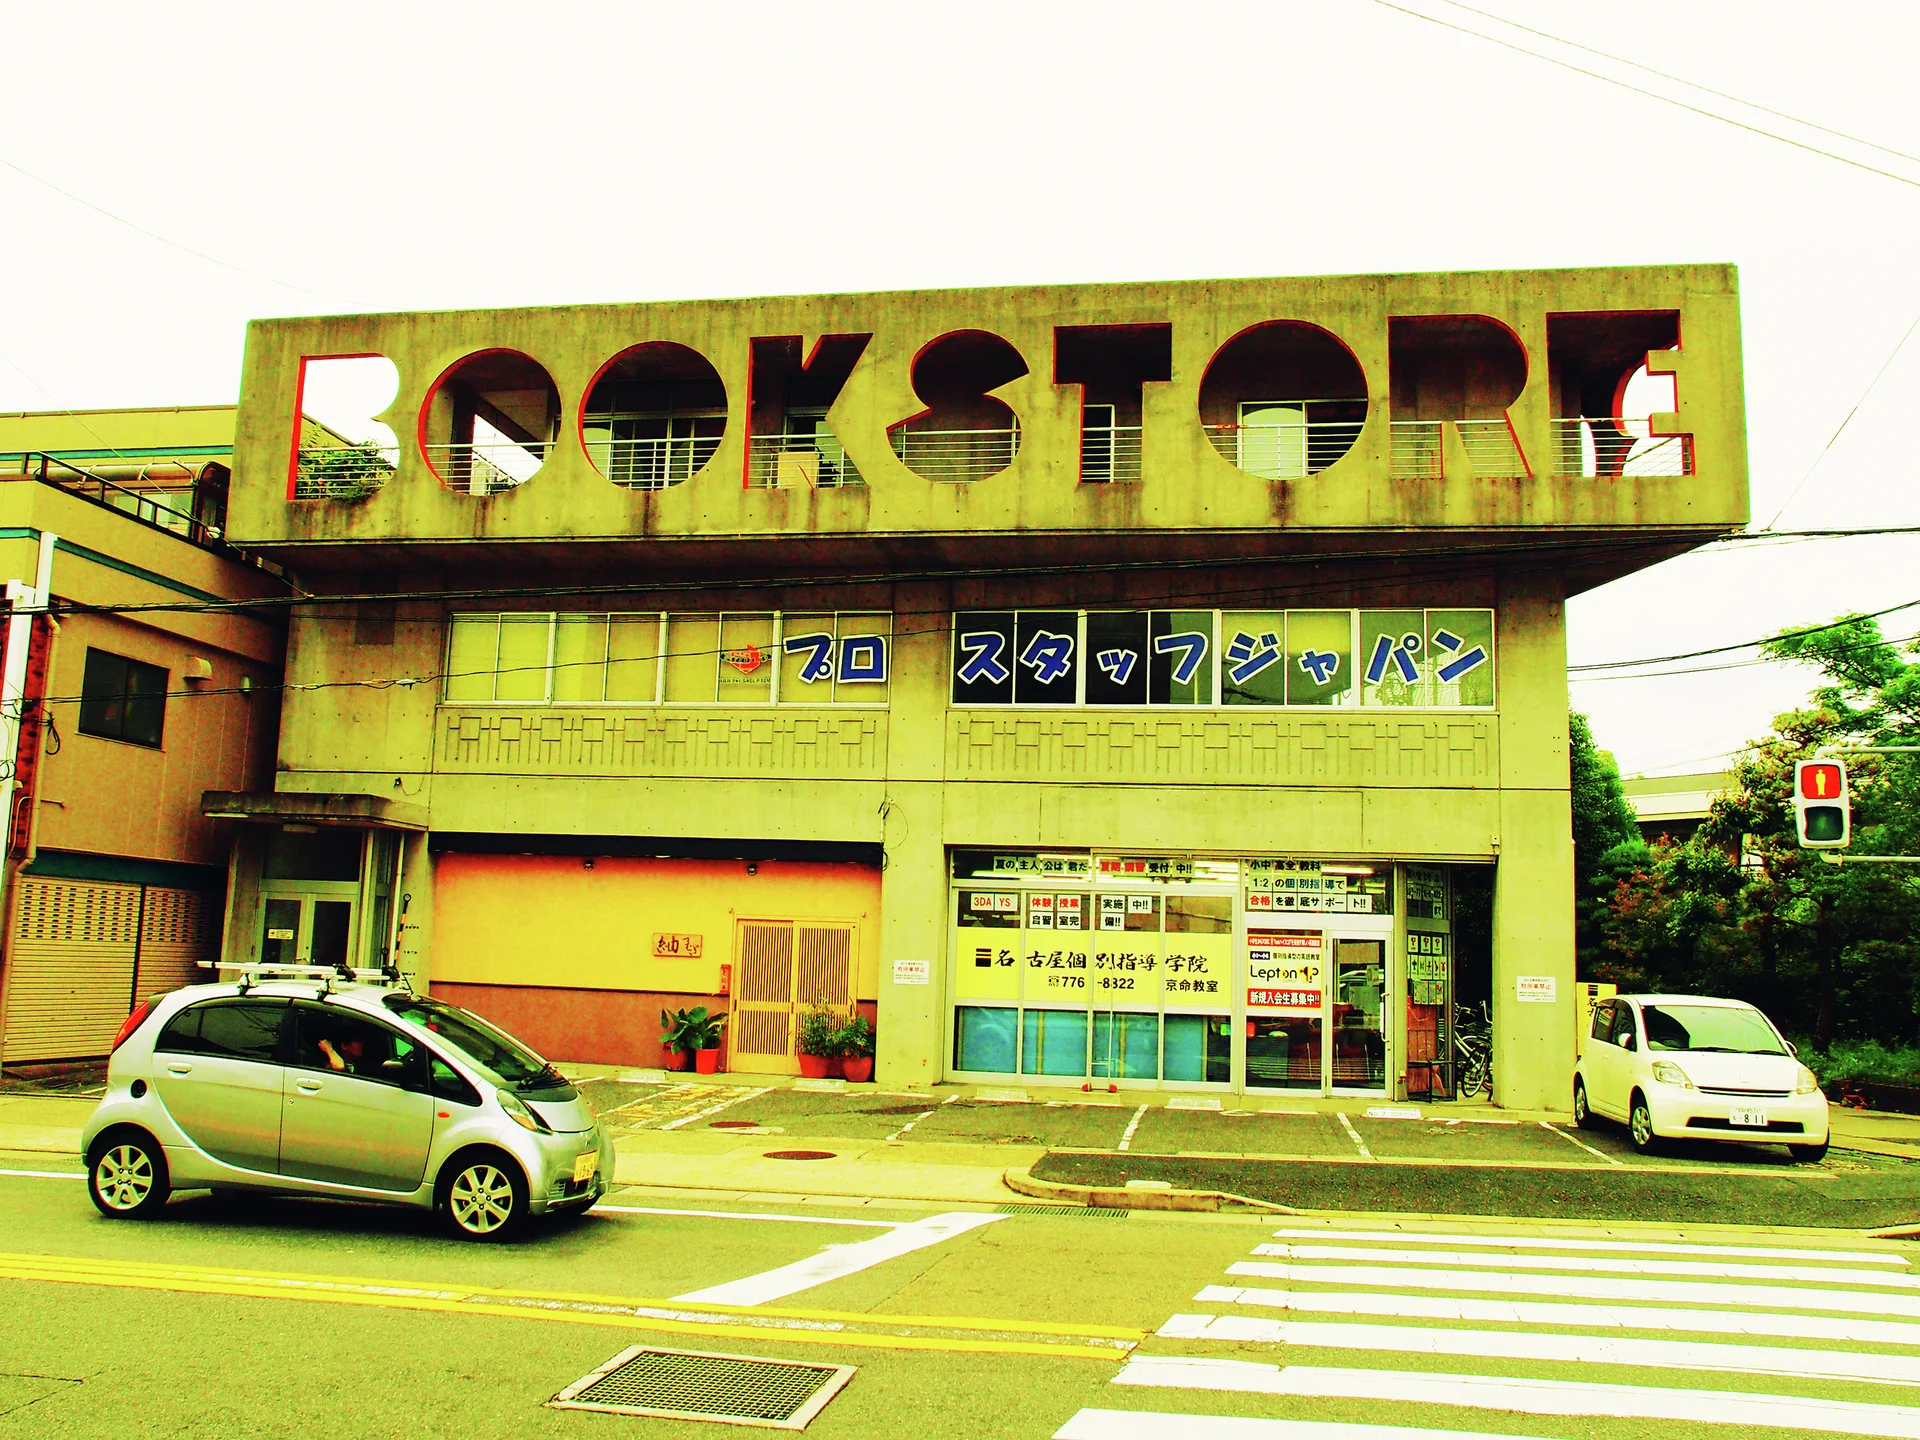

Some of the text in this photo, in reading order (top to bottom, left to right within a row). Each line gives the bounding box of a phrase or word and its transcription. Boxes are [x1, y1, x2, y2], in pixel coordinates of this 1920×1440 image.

[286, 309, 1696, 501] BOOKSTORE
[783, 629, 1490, 686] プロ スタッフジャパン
[1250, 964, 1298, 982] Lepton
